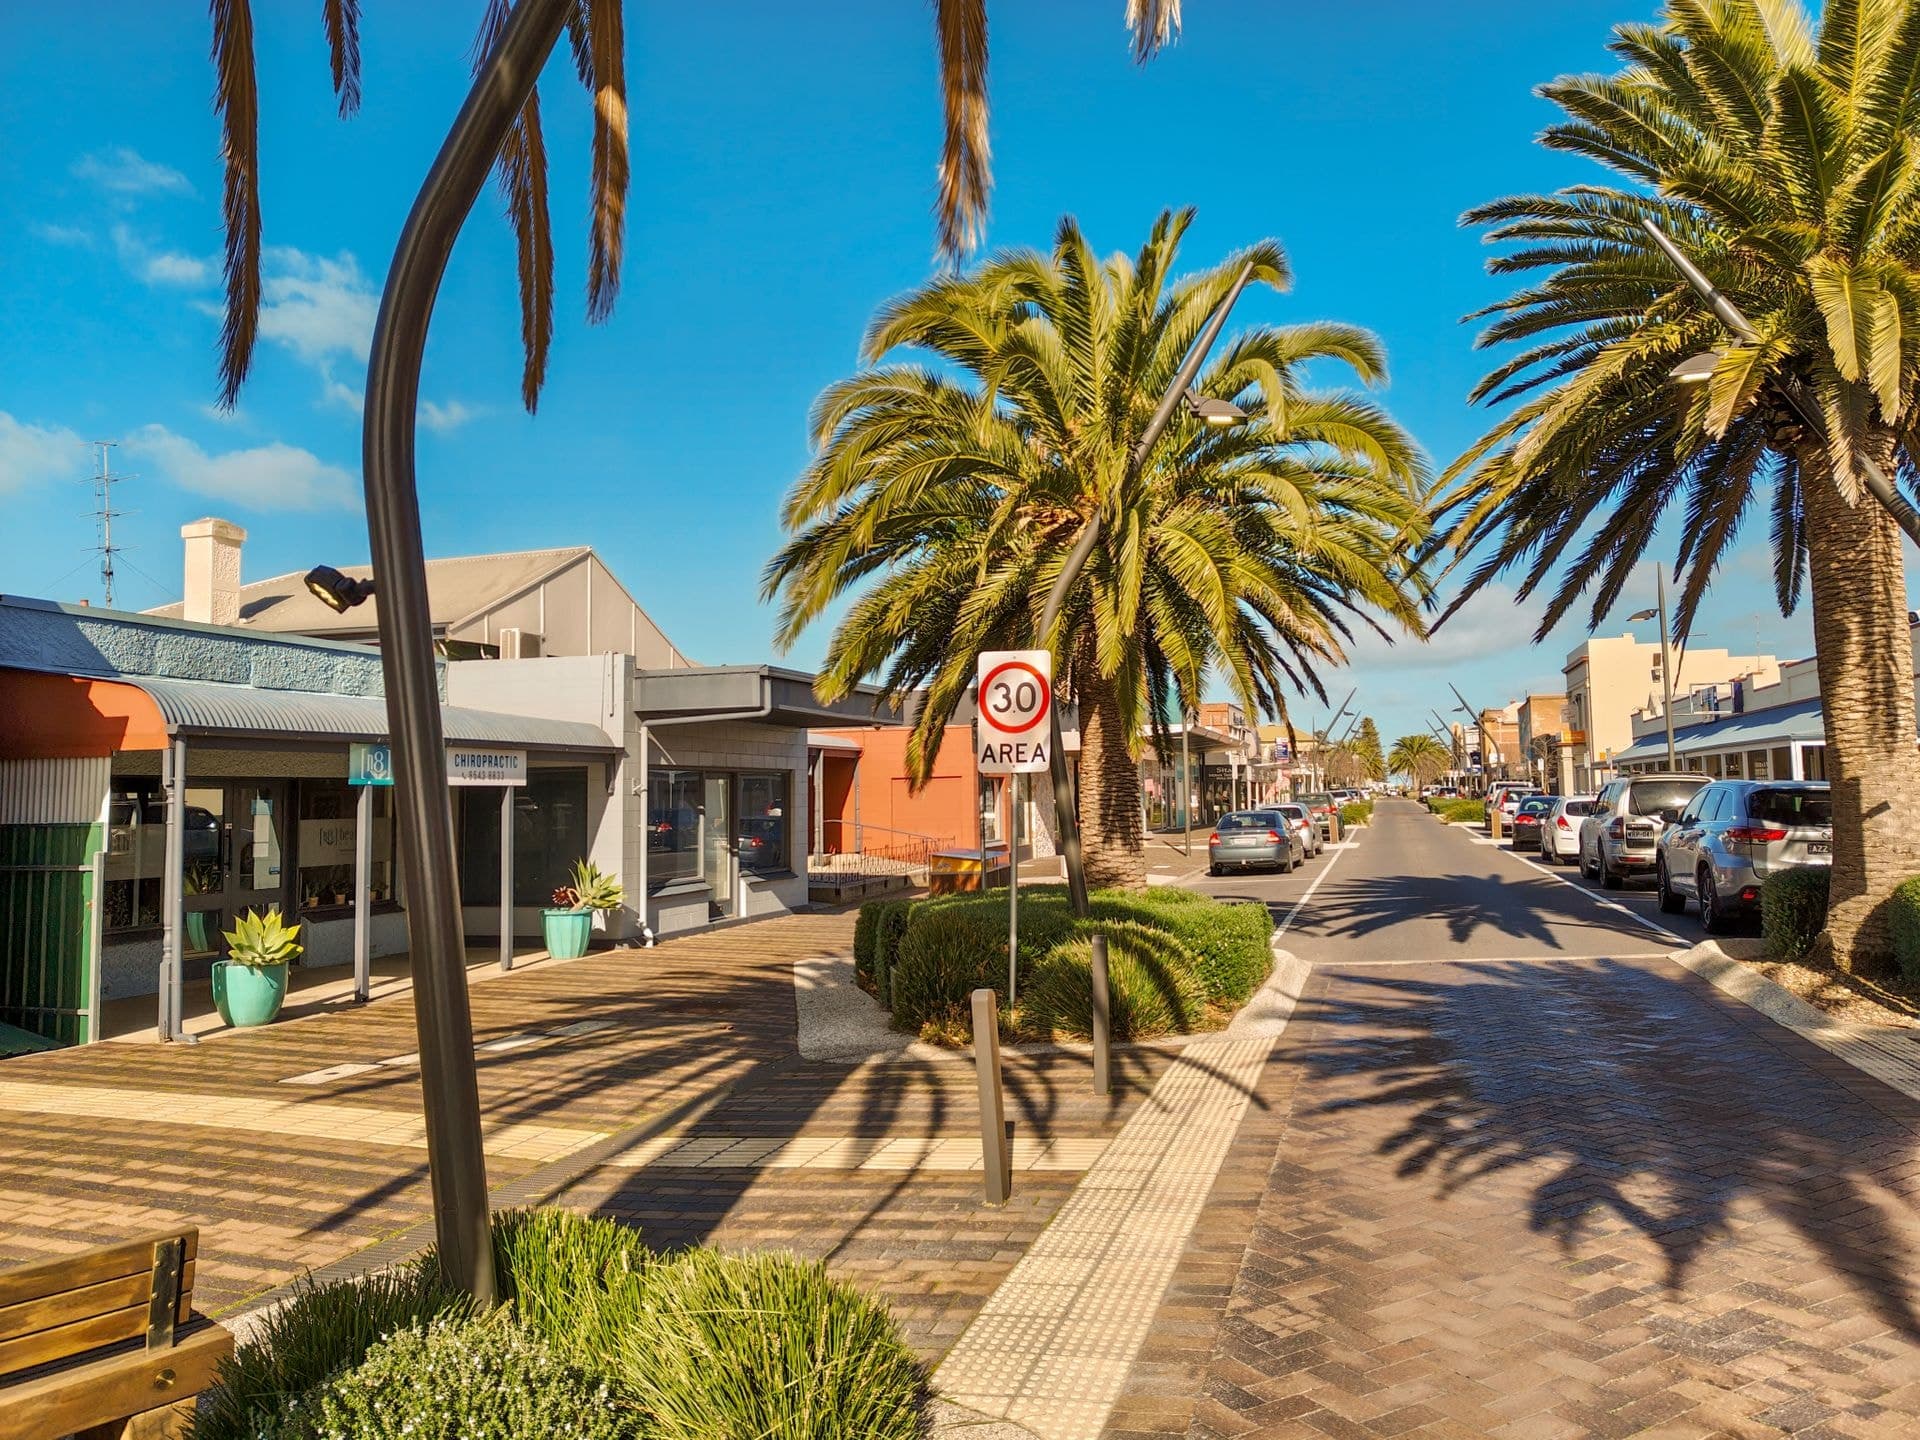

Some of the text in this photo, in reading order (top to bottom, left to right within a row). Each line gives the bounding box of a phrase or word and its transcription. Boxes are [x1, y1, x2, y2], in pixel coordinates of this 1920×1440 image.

[992, 682, 1037, 714] 30
[454, 753, 519, 769] CHIROPRACTIC
[981, 743, 1047, 764] AREA
